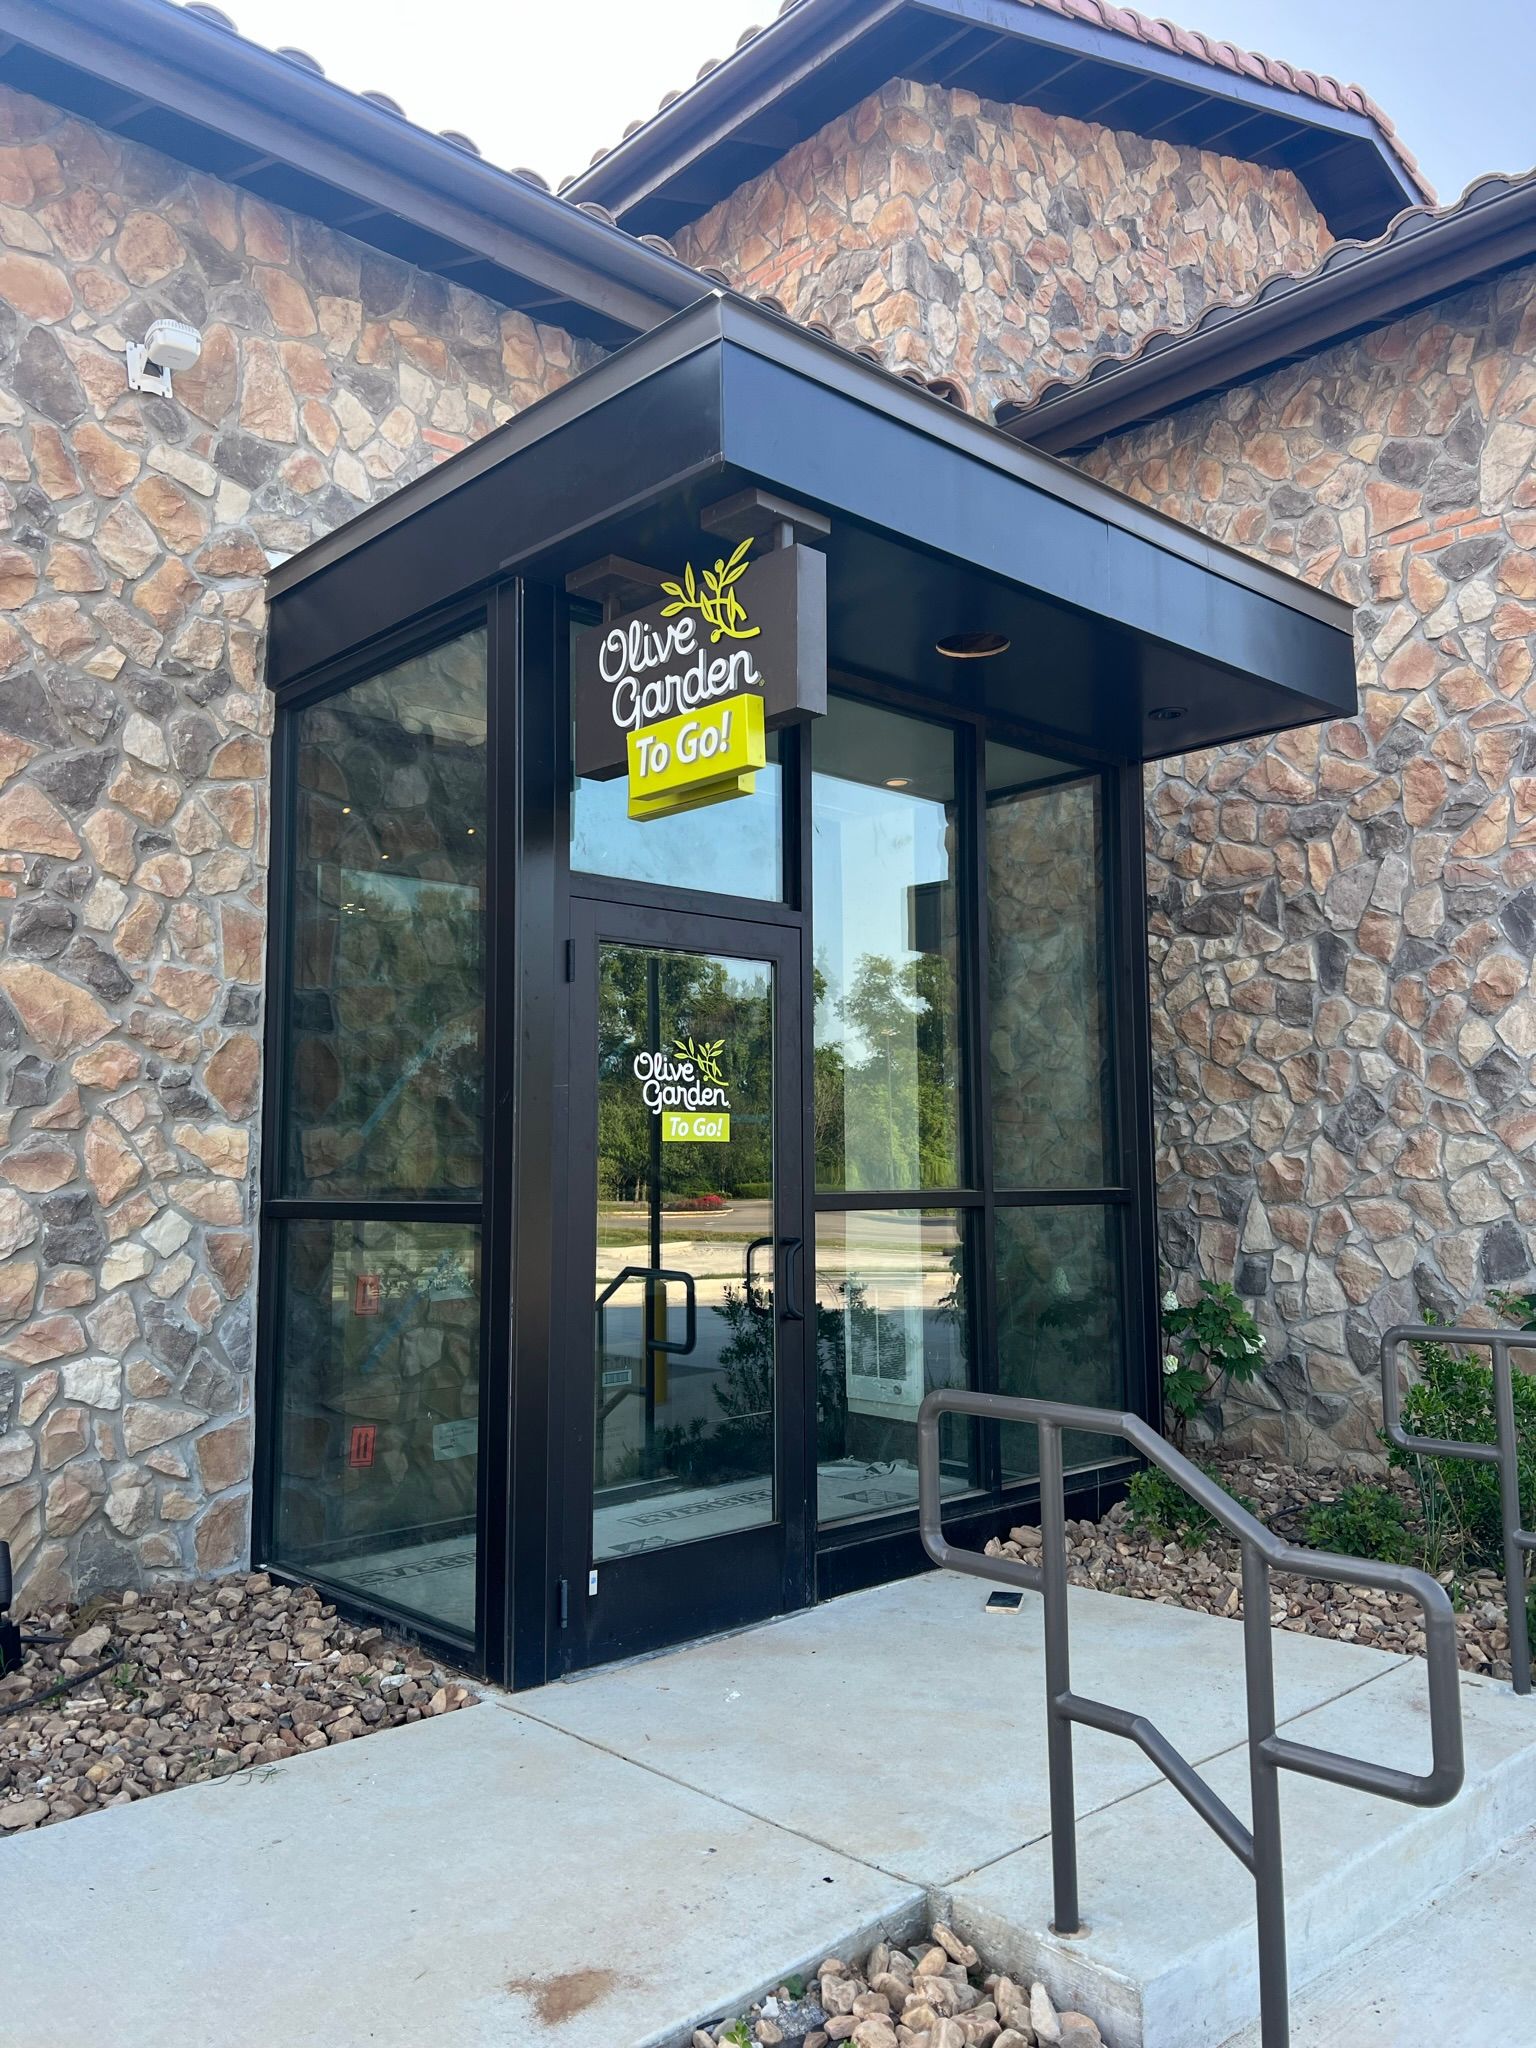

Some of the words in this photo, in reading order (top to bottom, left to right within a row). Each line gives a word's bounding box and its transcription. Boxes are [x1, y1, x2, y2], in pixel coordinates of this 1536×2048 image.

[599, 616, 698, 683] Olive
[612, 648, 762, 731] Garden
[635, 735, 671, 777] To
[676, 710, 733, 764] Go!
[634, 1052, 695, 1082] Olive
[643, 1080, 730, 1115] Garden
[669, 1117, 690, 1137] To
[693, 1117, 723, 1137] Go!
